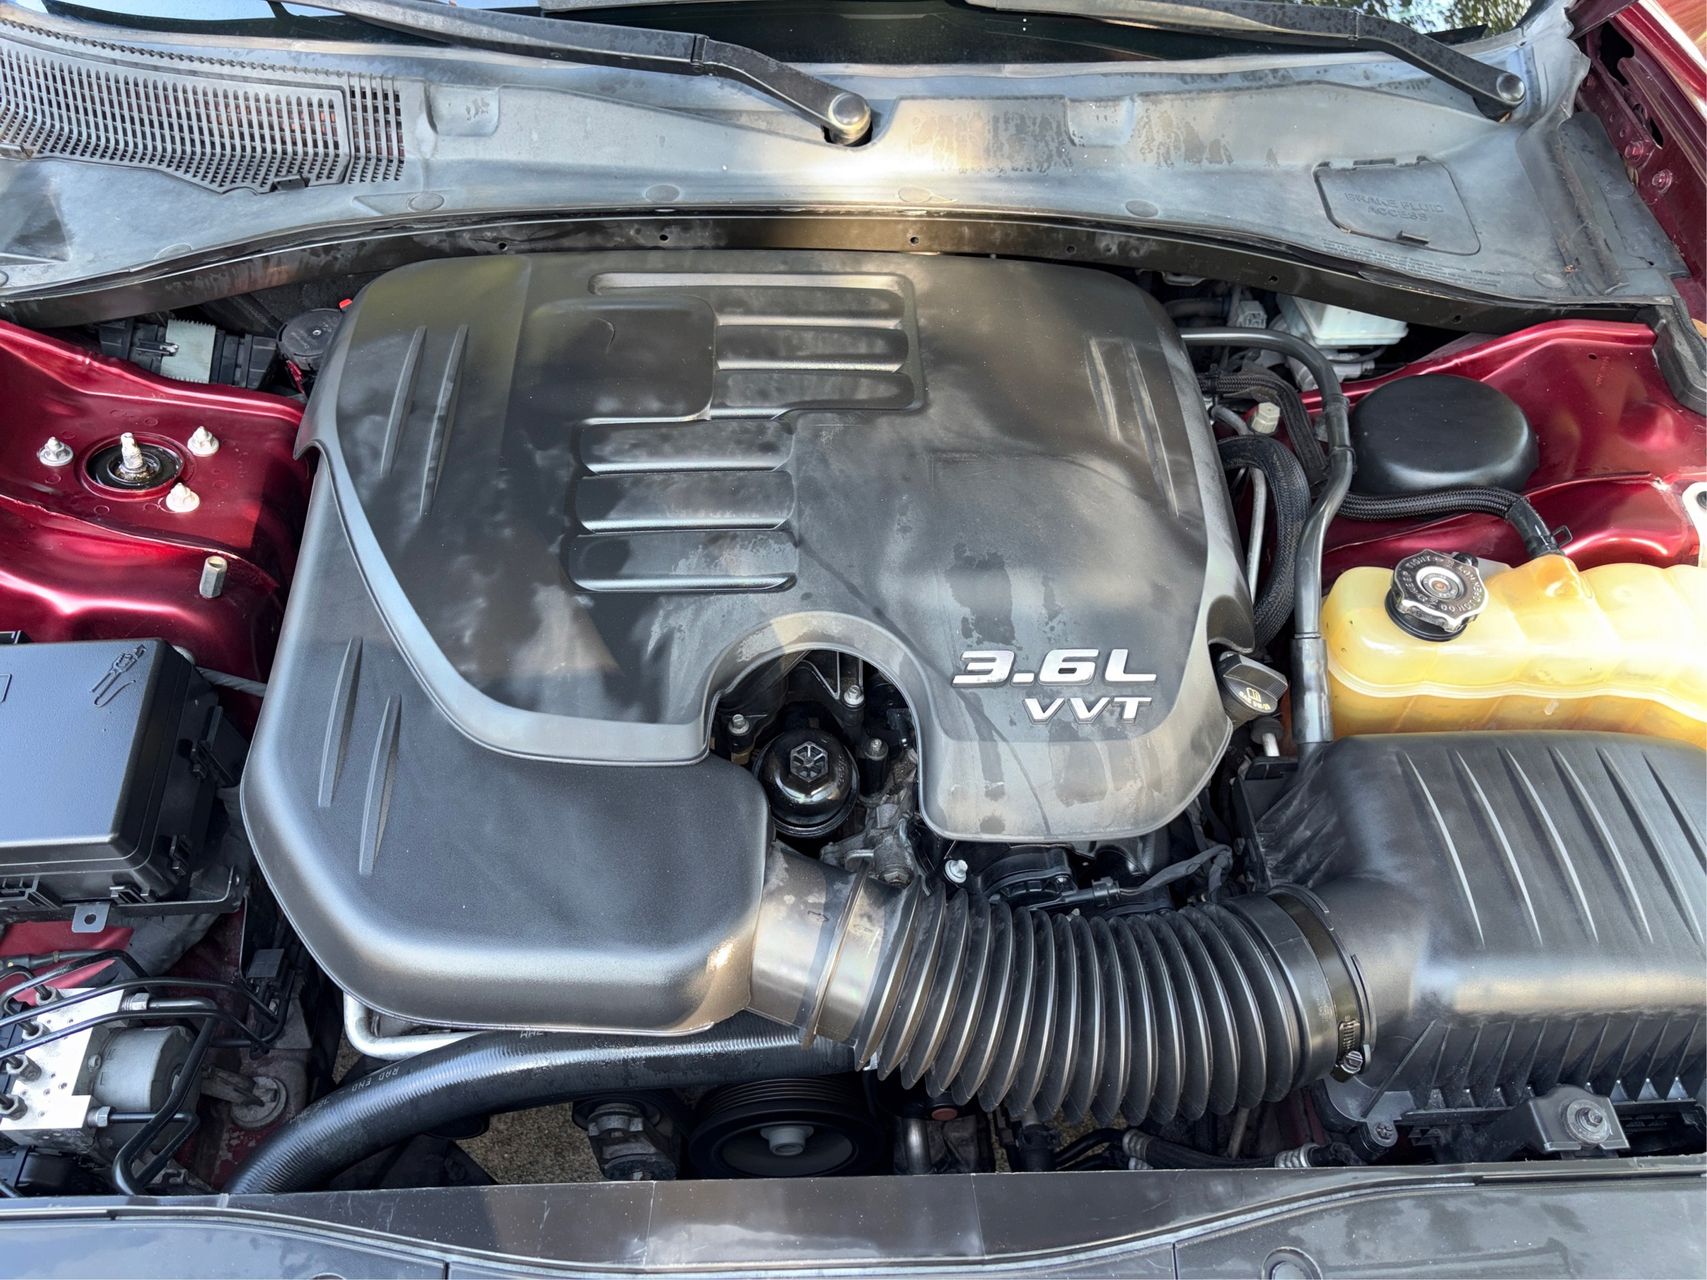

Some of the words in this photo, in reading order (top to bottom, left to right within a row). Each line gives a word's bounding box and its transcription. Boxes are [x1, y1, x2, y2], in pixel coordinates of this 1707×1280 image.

[1345, 191, 1397, 206] BRAKE
[1401, 201, 1444, 213] FLUID
[1368, 206, 1429, 222] ACCESS
[1405, 555, 1431, 569] TIGHT
[1402, 570, 1418, 594] KEEP
[952, 648, 1157, 687] 3.6L
[1023, 697, 1152, 724] VVT
[379, 1066, 400, 1081] RAD
[351, 1078, 372, 1091] END
